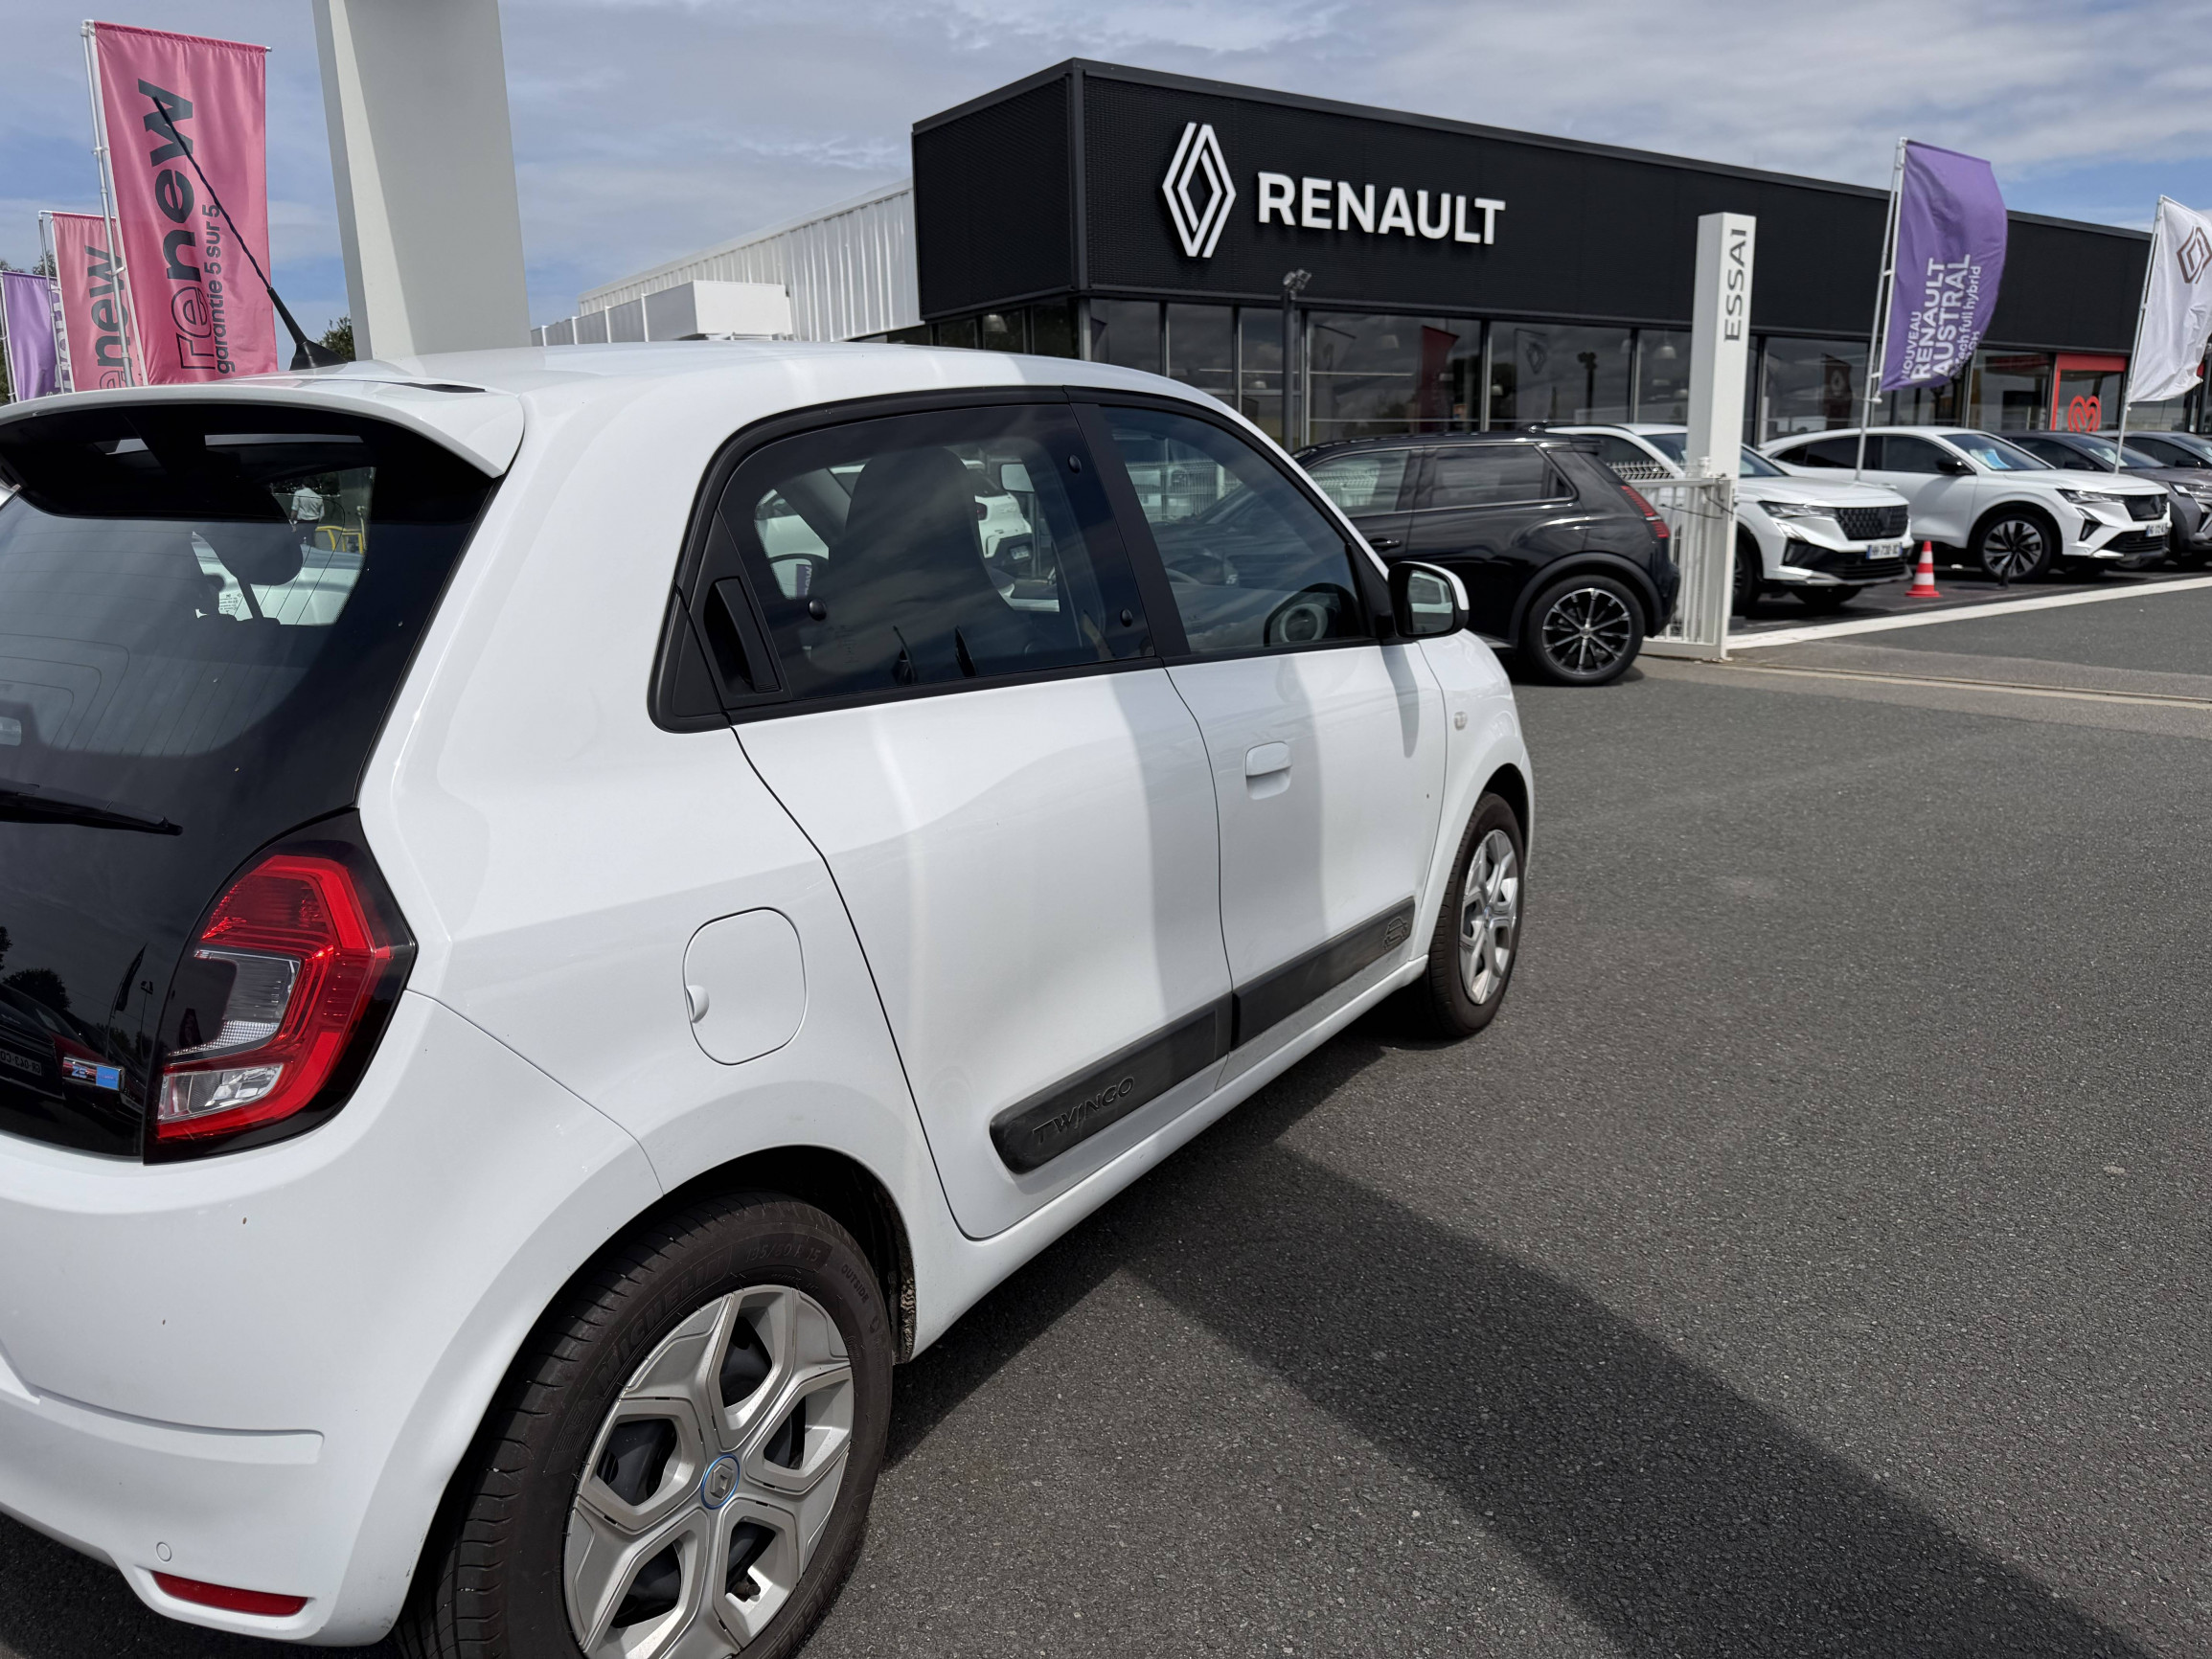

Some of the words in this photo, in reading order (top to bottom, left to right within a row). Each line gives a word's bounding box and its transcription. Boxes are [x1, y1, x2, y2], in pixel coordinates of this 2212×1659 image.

[138, 79, 216, 371] renew
[202, 204, 220, 217] 5
[205, 221, 221, 258] sur
[1258, 170, 1506, 245] RENAULT
[203, 262, 222, 275] 5
[1724, 229, 1747, 342] ESSAI
[1962, 265, 1982, 309] hybrid
[207, 281, 236, 375] garantie
[1910, 257, 1945, 379] RENAULT
[1932, 254, 1971, 376] AUSTRAL
[1032, 1076, 1135, 1145] TWINGO
[841, 1264, 870, 1304] OUTSIDE
